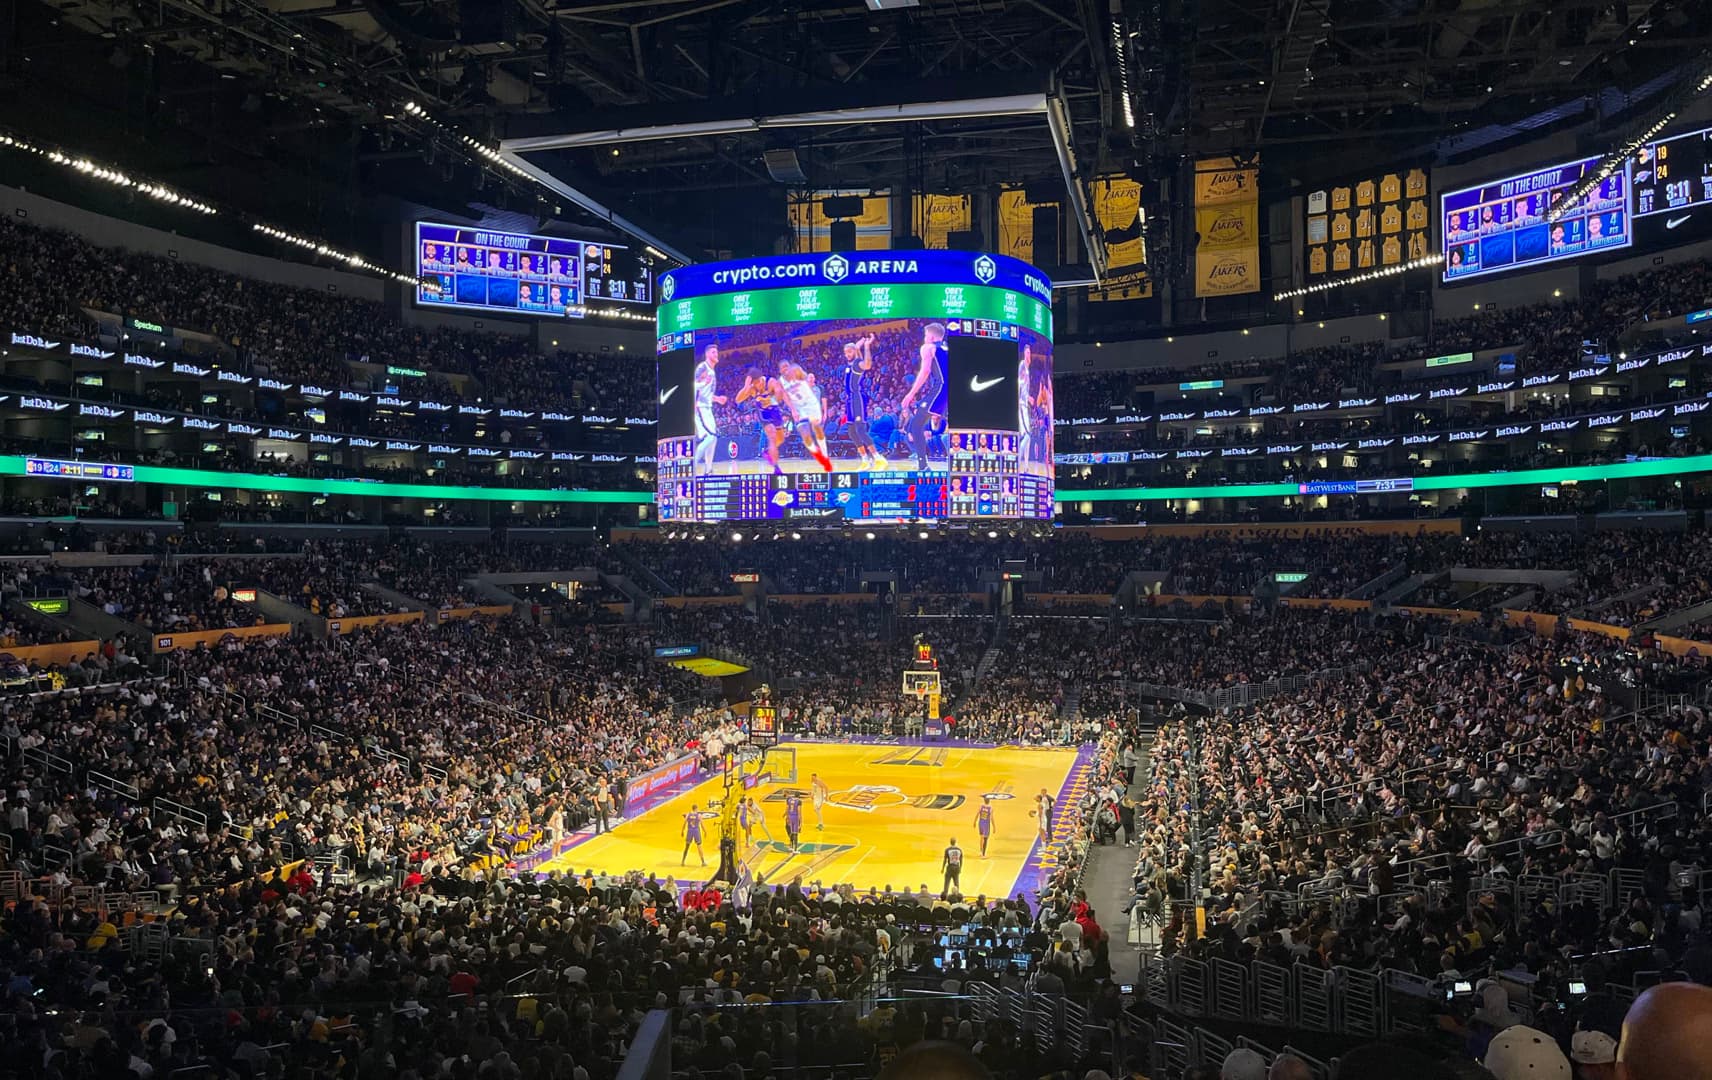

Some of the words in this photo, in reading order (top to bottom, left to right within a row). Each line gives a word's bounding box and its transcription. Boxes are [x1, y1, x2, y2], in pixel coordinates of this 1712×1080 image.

[1657, 146, 1667, 160] 19
[1657, 165, 1667, 179] 24
[1385, 185, 1396, 193] 44
[1501, 184, 1514, 198] ON
[1516, 178, 1531, 192] THE
[1532, 170, 1562, 190] COURT
[1610, 177, 1616, 191] 3
[1104, 189, 1138, 200] LAKERS
[1666, 180, 1690, 201] 3:11
[1312, 193, 1322, 202] 99
[1536, 194, 1542, 206] 3
[1502, 203, 1507, 215] 5
[1386, 216, 1397, 225] 32
[1469, 211, 1474, 222] 2
[1610, 213, 1617, 225] 4
[1210, 220, 1244, 233] LAKERS
[1336, 224, 1347, 233] 52
[1573, 221, 1579, 233] 0
[475, 232, 487, 244] ON
[489, 235, 503, 246] THE
[504, 236, 531, 249] COURT
[444, 247, 450, 256] 2
[604, 249, 611, 260] 19
[1469, 244, 1475, 255] 9
[538, 257, 544, 266] 2
[604, 264, 611, 274] 24
[713, 264, 815, 285] crypto.com
[855, 261, 918, 274] ARENA
[1209, 265, 1248, 279] LAKERS
[609, 280, 626, 293] 3:11
[963, 321, 972, 332] 19
[981, 321, 996, 330] 3:11
[34, 464, 43, 472] 19
[50, 465, 59, 473] 24
[65, 465, 80, 474] 3:11
[777, 476, 788, 489] 19
[804, 474, 822, 482] 3:11
[838, 476, 852, 488] 24
[1376, 481, 1395, 490] 7:31
